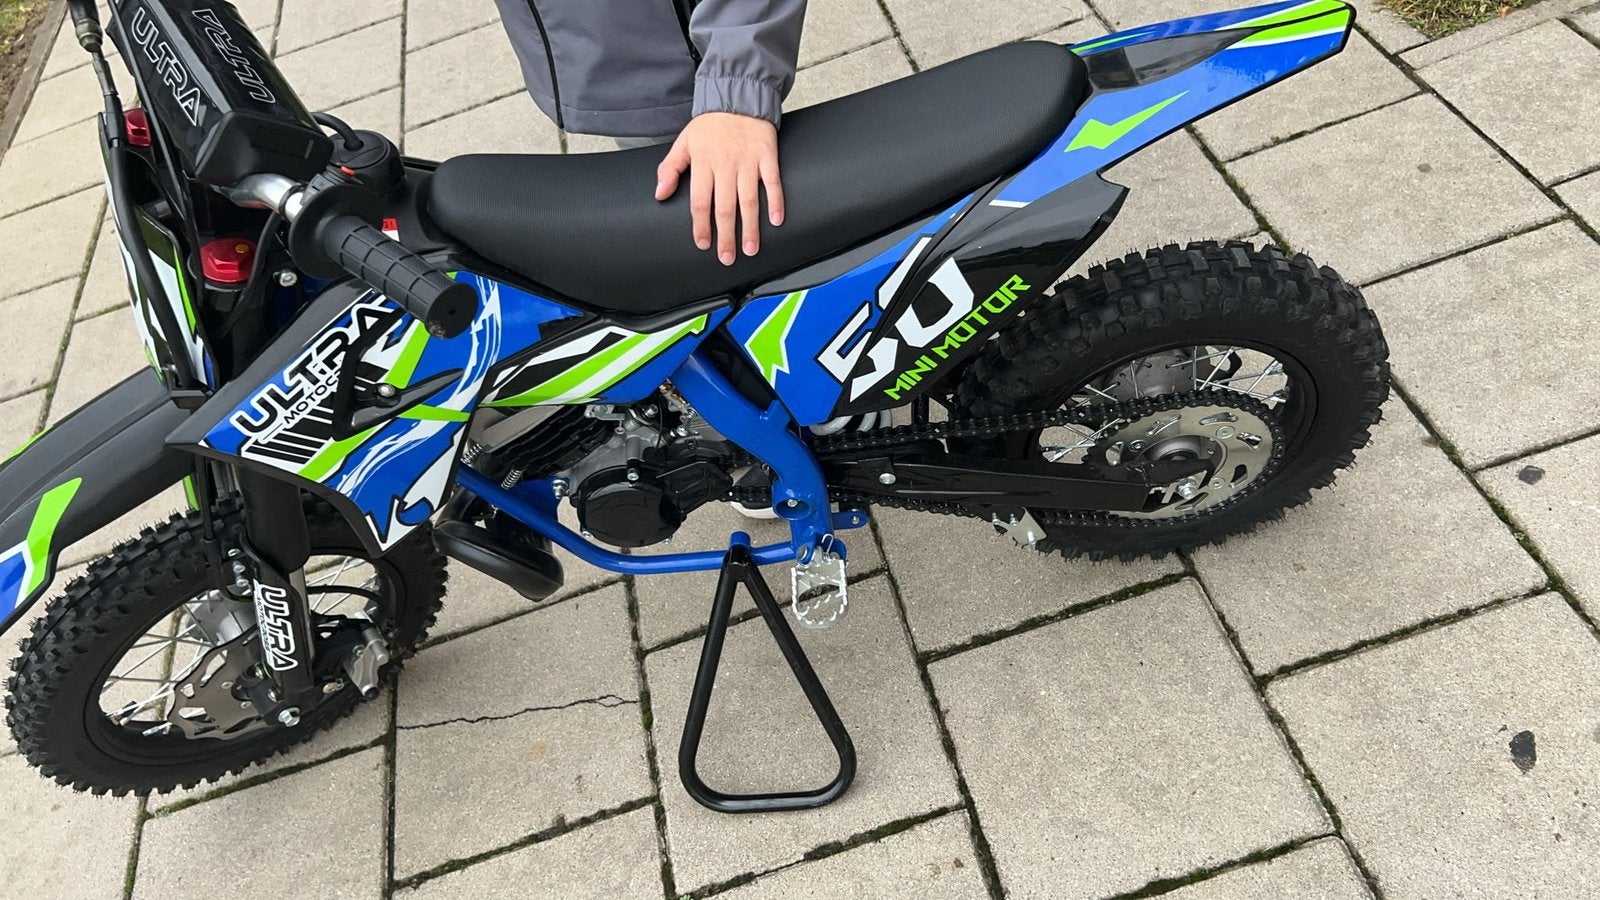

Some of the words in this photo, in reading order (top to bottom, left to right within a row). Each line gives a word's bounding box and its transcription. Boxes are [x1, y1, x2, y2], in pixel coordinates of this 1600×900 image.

[131, 6, 201, 127] ULTRA
[192, 8, 276, 104] ULTRA
[232, 303, 402, 434] ULTRA
[817, 236, 975, 403] 50
[883, 354, 939, 401] MINI
[931, 273, 1032, 359] MOTOR
[284, 370, 341, 426] MOTOC
[259, 584, 297, 670] ULTRA
